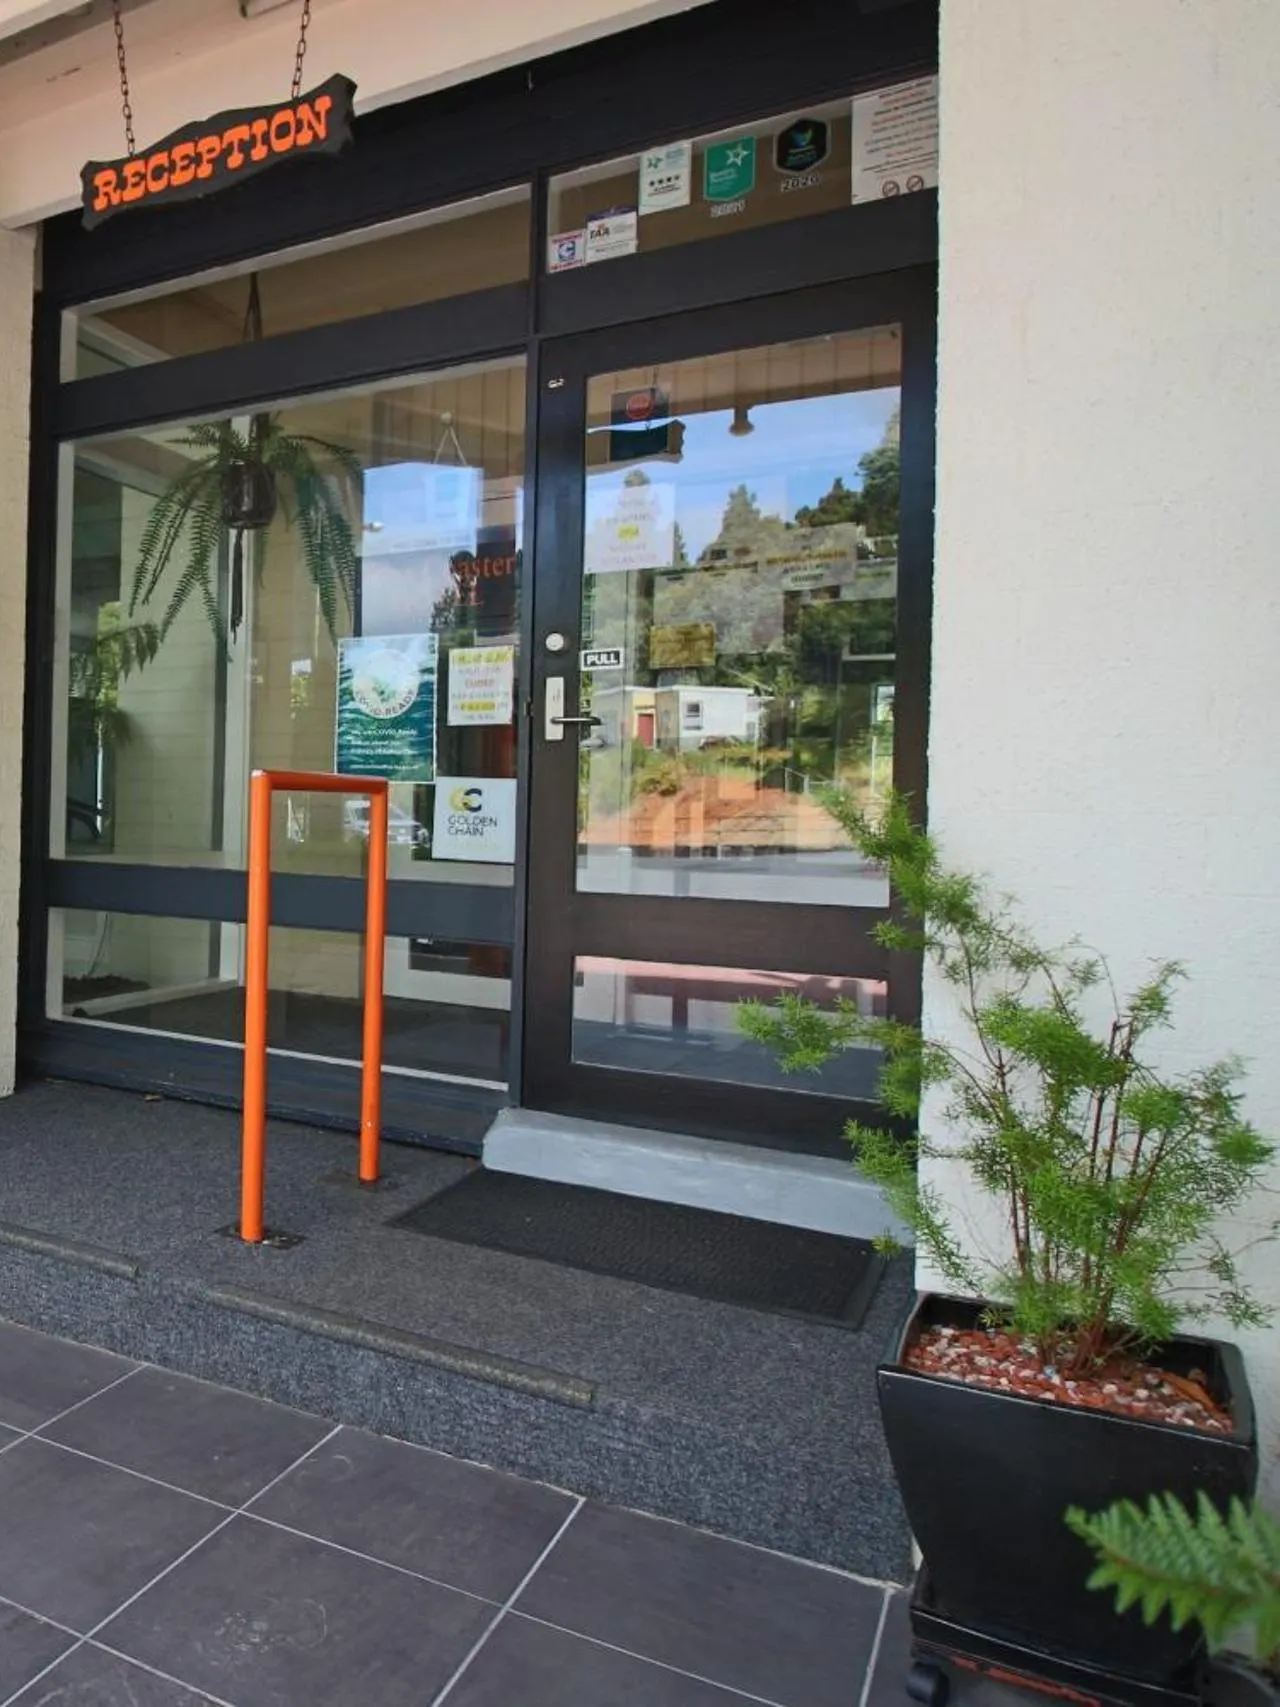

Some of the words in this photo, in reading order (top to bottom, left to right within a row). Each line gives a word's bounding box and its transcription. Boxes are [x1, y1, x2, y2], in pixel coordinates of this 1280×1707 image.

[93, 96, 332, 211] RECEPTION
[586, 654, 618, 665] PULL
[448, 815, 497, 827] GOLDEN
[448, 826, 484, 837] CHAIN
